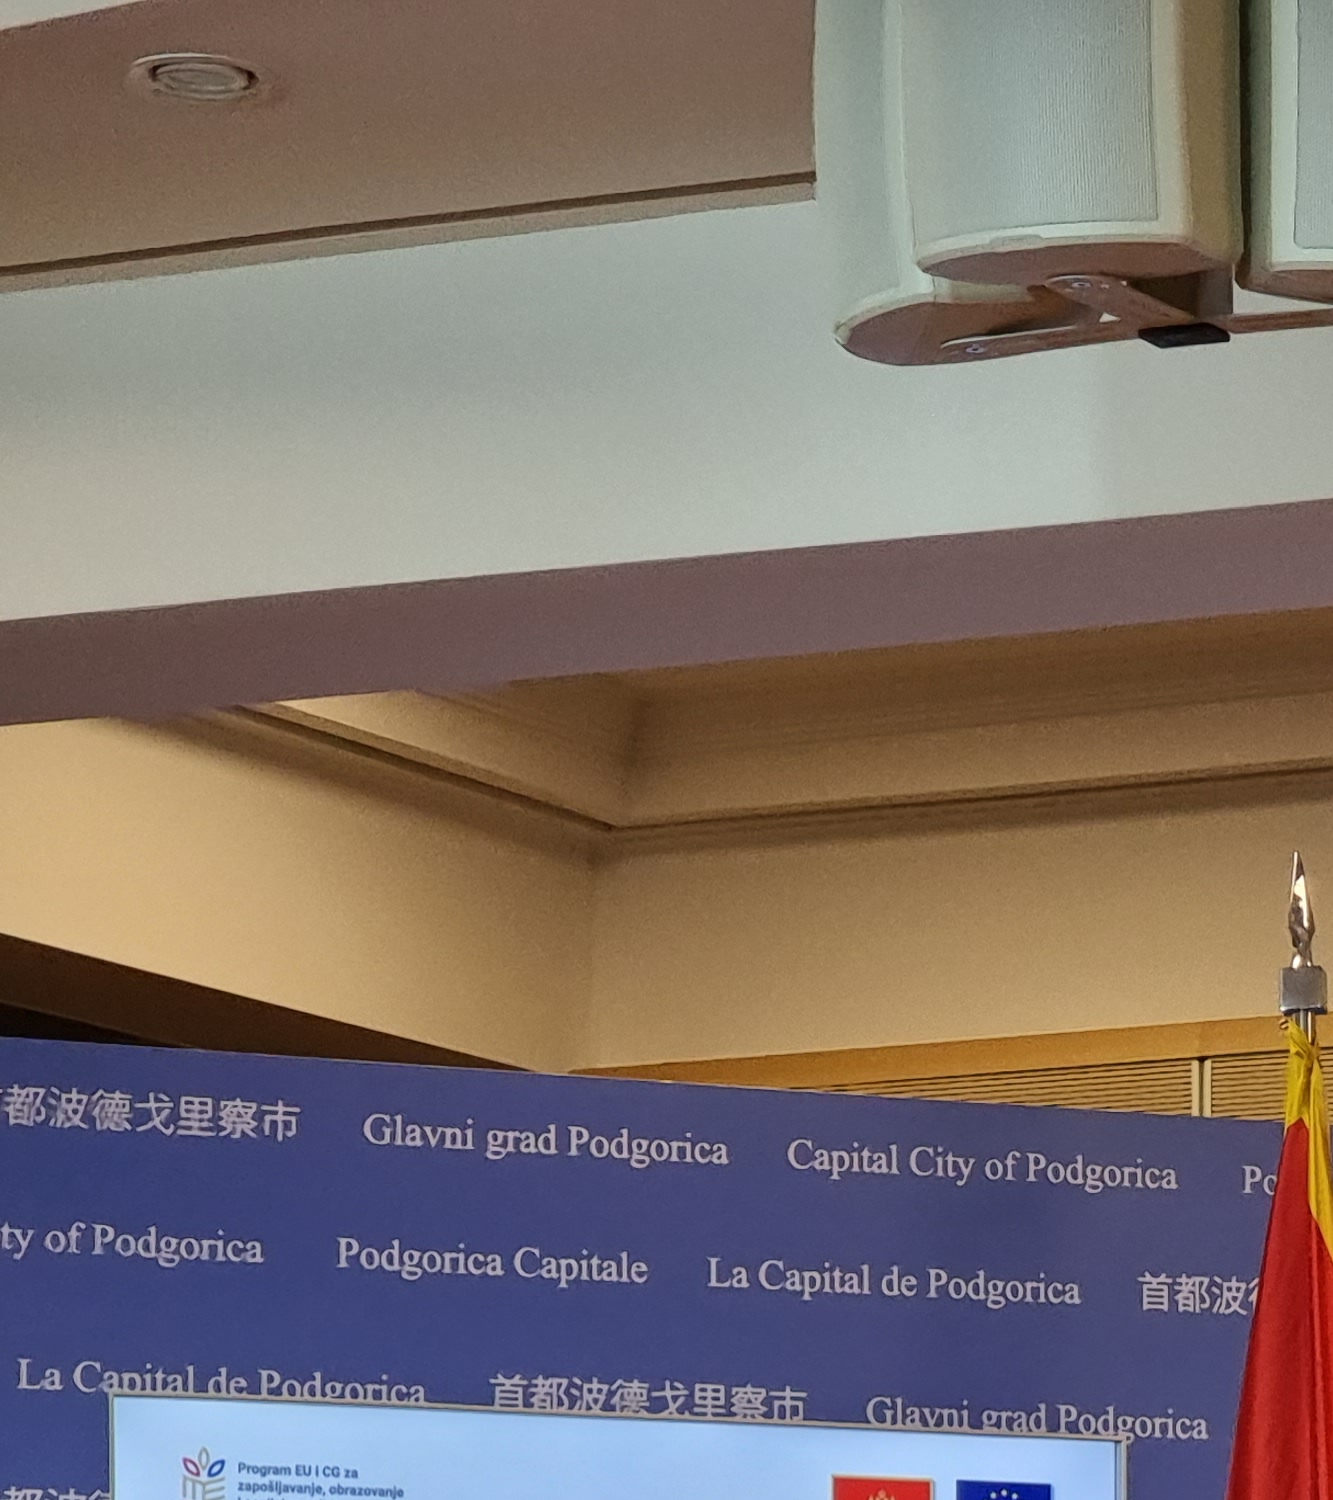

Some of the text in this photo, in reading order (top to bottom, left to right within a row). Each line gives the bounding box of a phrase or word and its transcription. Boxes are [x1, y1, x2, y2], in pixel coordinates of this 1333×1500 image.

[0, 1084, 301, 1142] 都波德戈里察市
[363, 1112, 729, 1168] Glavni grad Podgorica
[787, 1138, 900, 1180] Capital
[908, 1145, 975, 1186] City
[984, 1148, 1020, 1181] of
[1025, 1152, 1178, 1194] Podgorica
[44, 1221, 87, 1255] of
[90, 1223, 265, 1269] Podgorica
[336, 1237, 649, 1290] Podgorica Capitale
[707, 1257, 1082, 1311] La Capital de Podgorica
[17, 1359, 426, 1403] La Capital de Podgorica
[866, 1396, 970, 1430] Glavni
[981, 1403, 1047, 1431] grad
[1056, 1403, 1209, 1440] Podgorica
[237, 1480, 404, 1500] zapošljavanje, obrazovanje
[238, 1462, 291, 1477] Program
[295, 1464, 312, 1476] EU
[322, 1466, 340, 1478] CG
[344, 1469, 358, 1478] za
